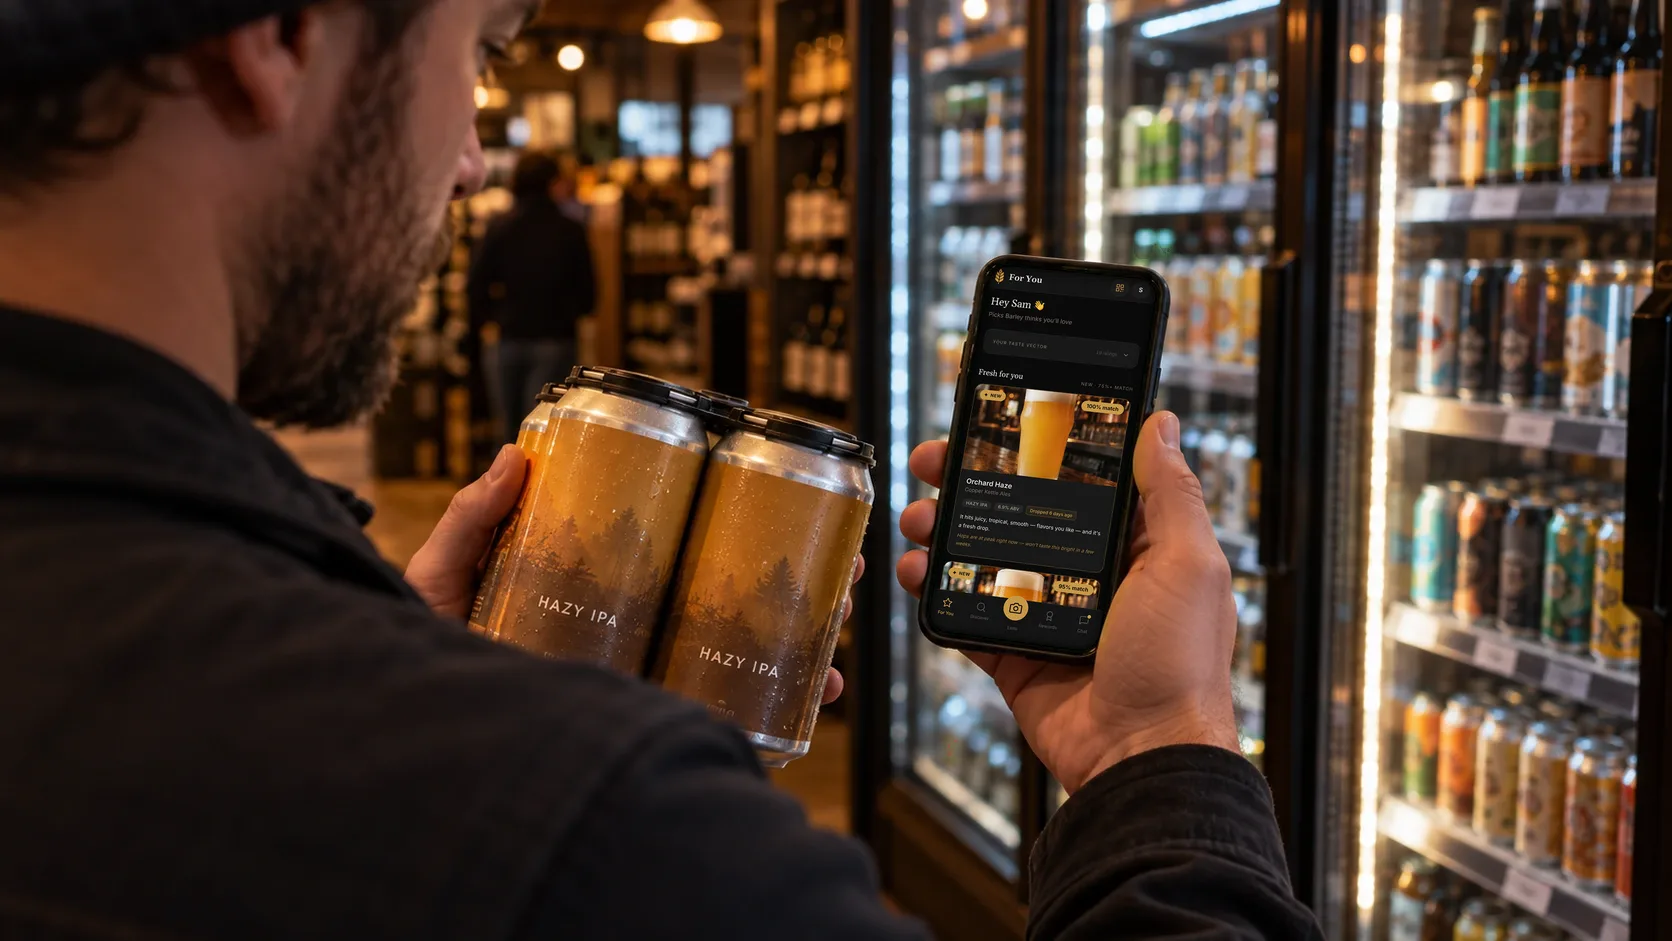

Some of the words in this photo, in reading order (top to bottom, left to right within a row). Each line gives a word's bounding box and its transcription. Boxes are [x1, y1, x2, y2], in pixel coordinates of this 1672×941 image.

[1009, 273, 1024, 282] For
[1026, 274, 1042, 284] You
[991, 296, 1010, 308] Hey
[1011, 298, 1032, 309] Sam
[1005, 312, 1024, 321] Barley
[978, 368, 998, 377] Fresh
[998, 370, 1010, 378] for
[966, 478, 994, 487] Orchard
[994, 481, 1012, 490] Haze
[1030, 508, 1048, 516] Dropped
[974, 516, 988, 524] juicy,
[988, 518, 1009, 526] tropical,
[538, 595, 585, 618] HAZY
[590, 609, 617, 628] IPA
[700, 646, 746, 669] HAZY
[752, 660, 778, 678] IPA
